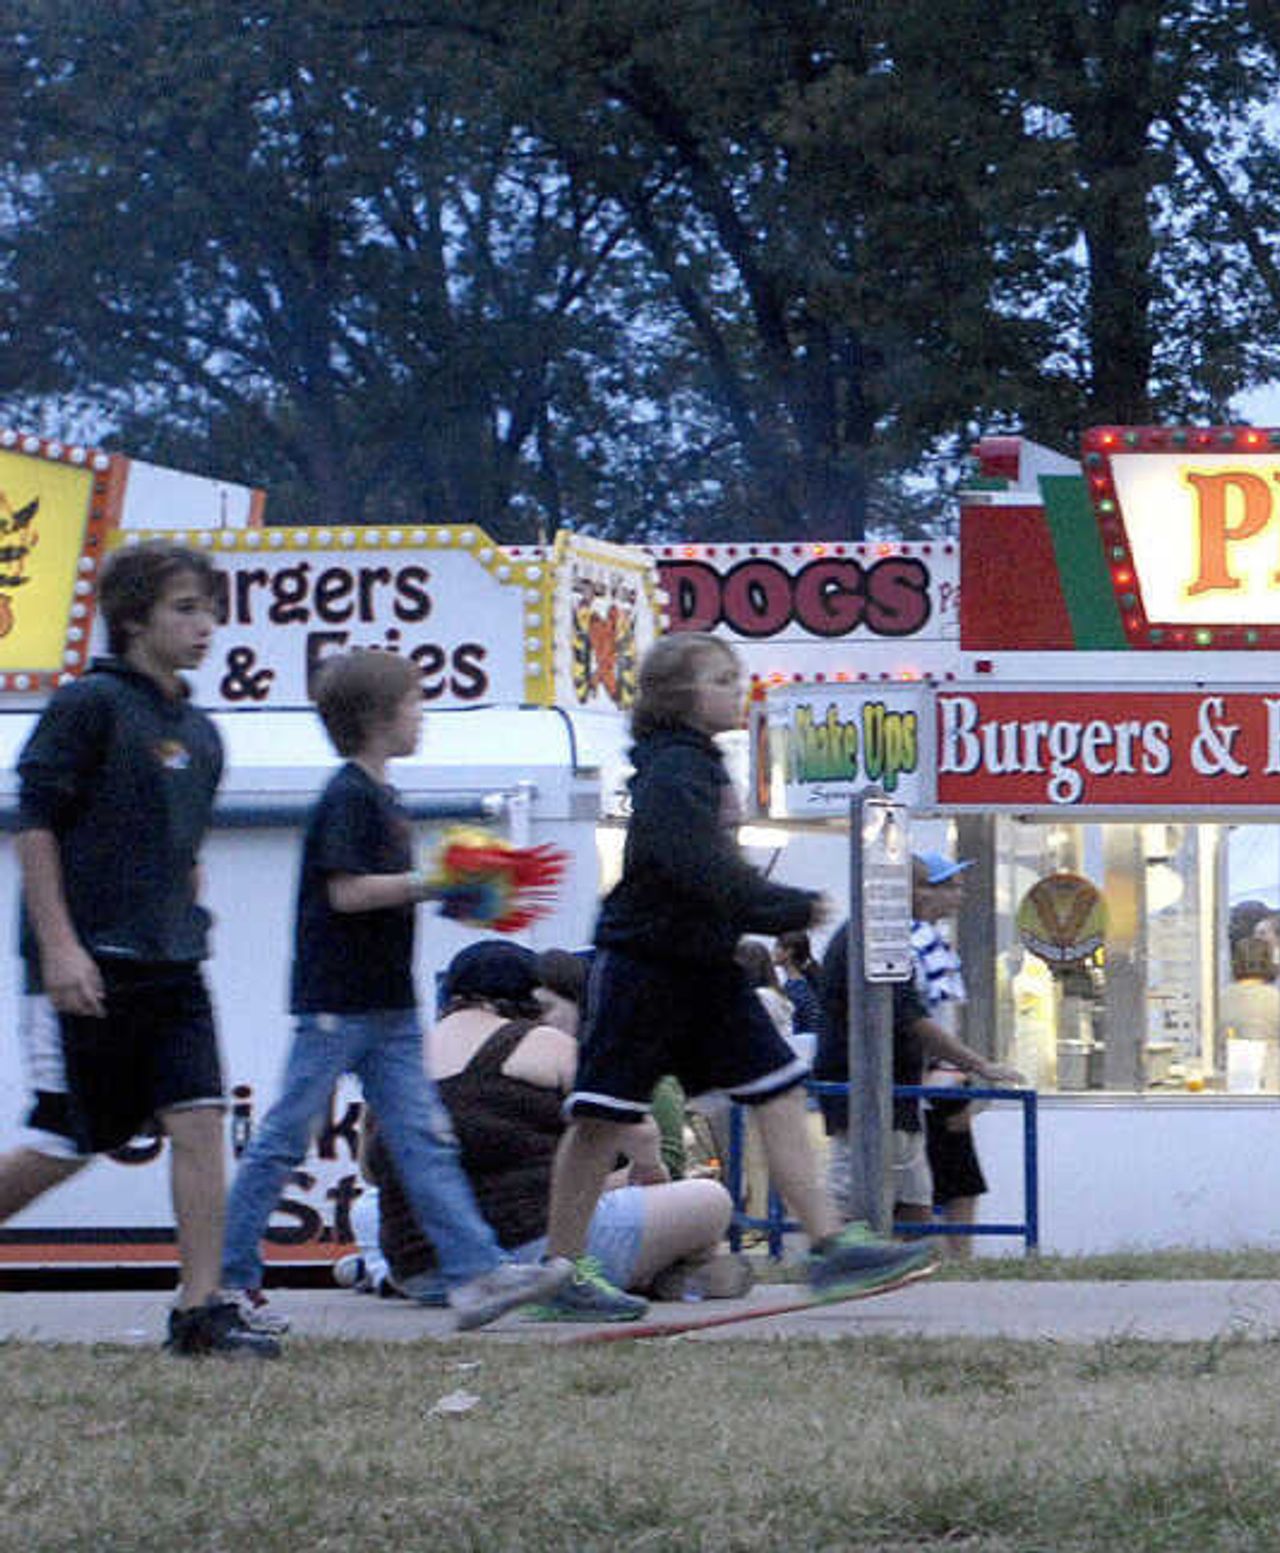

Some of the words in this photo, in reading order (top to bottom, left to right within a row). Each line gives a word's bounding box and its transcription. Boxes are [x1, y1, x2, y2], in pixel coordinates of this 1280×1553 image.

[656, 557, 931, 638] DOGS
[220, 646, 275, 701] &
[938, 696, 1171, 804] Burgers
[1191, 697, 1248, 777] &
